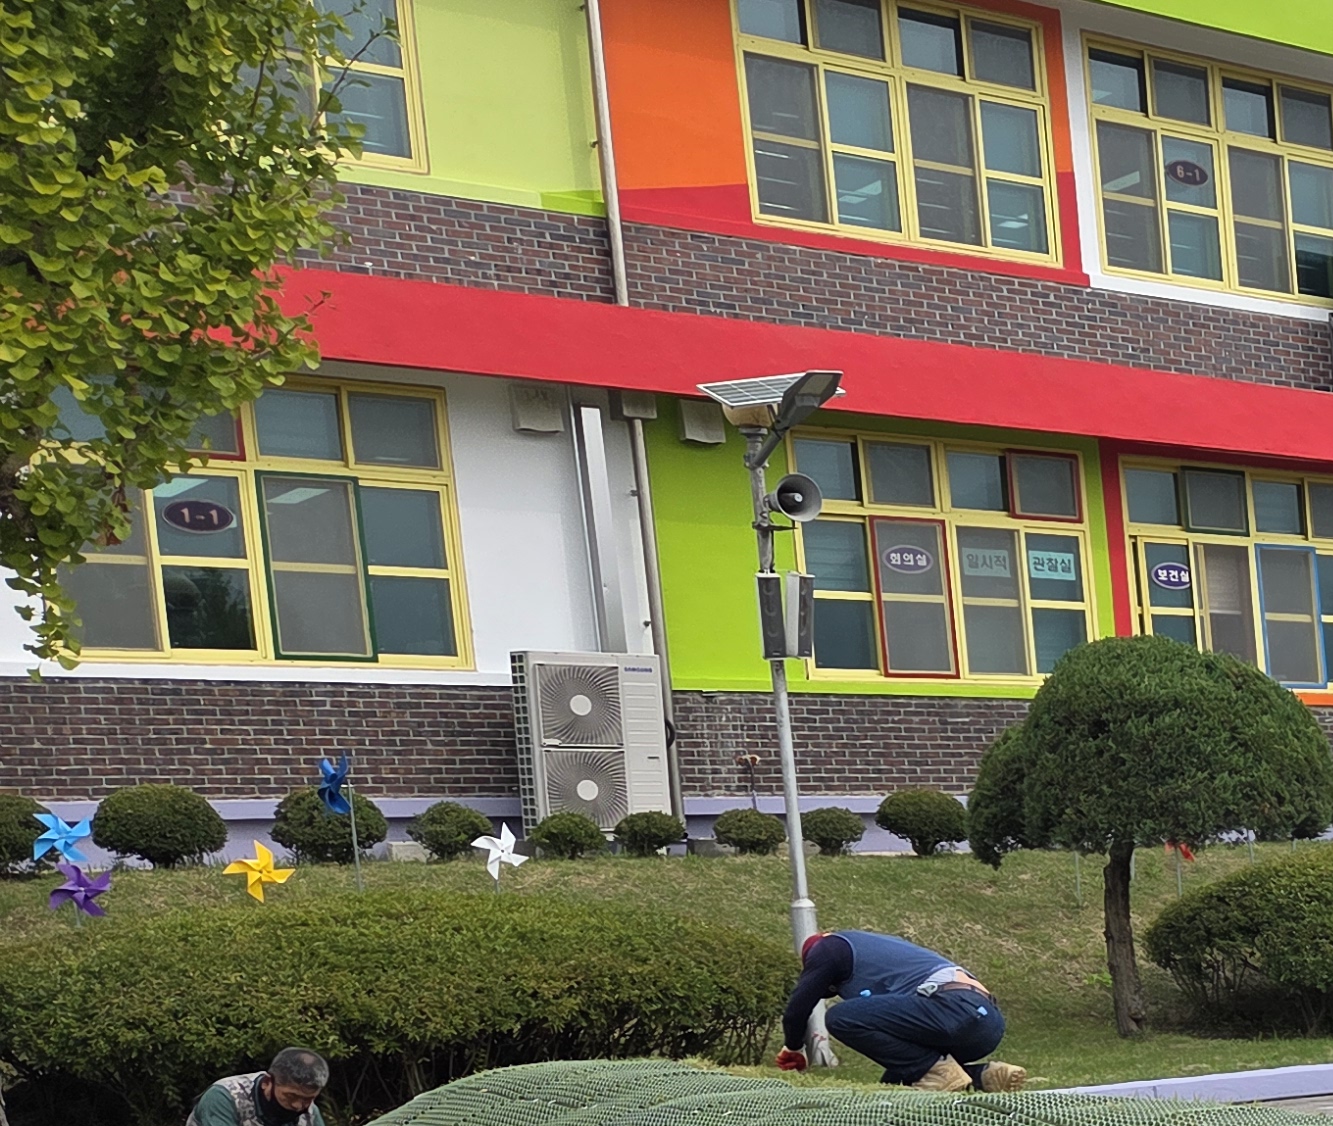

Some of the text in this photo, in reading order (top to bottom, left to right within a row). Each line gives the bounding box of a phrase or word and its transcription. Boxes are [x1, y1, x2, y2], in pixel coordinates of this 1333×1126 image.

[1176, 164, 1200, 182] 6-1
[180, 507, 219, 526] 1-1
[889, 552, 927, 566] 회의실
[966, 553, 1008, 571] 일시적
[1157, 569, 1190, 583] 보건실
